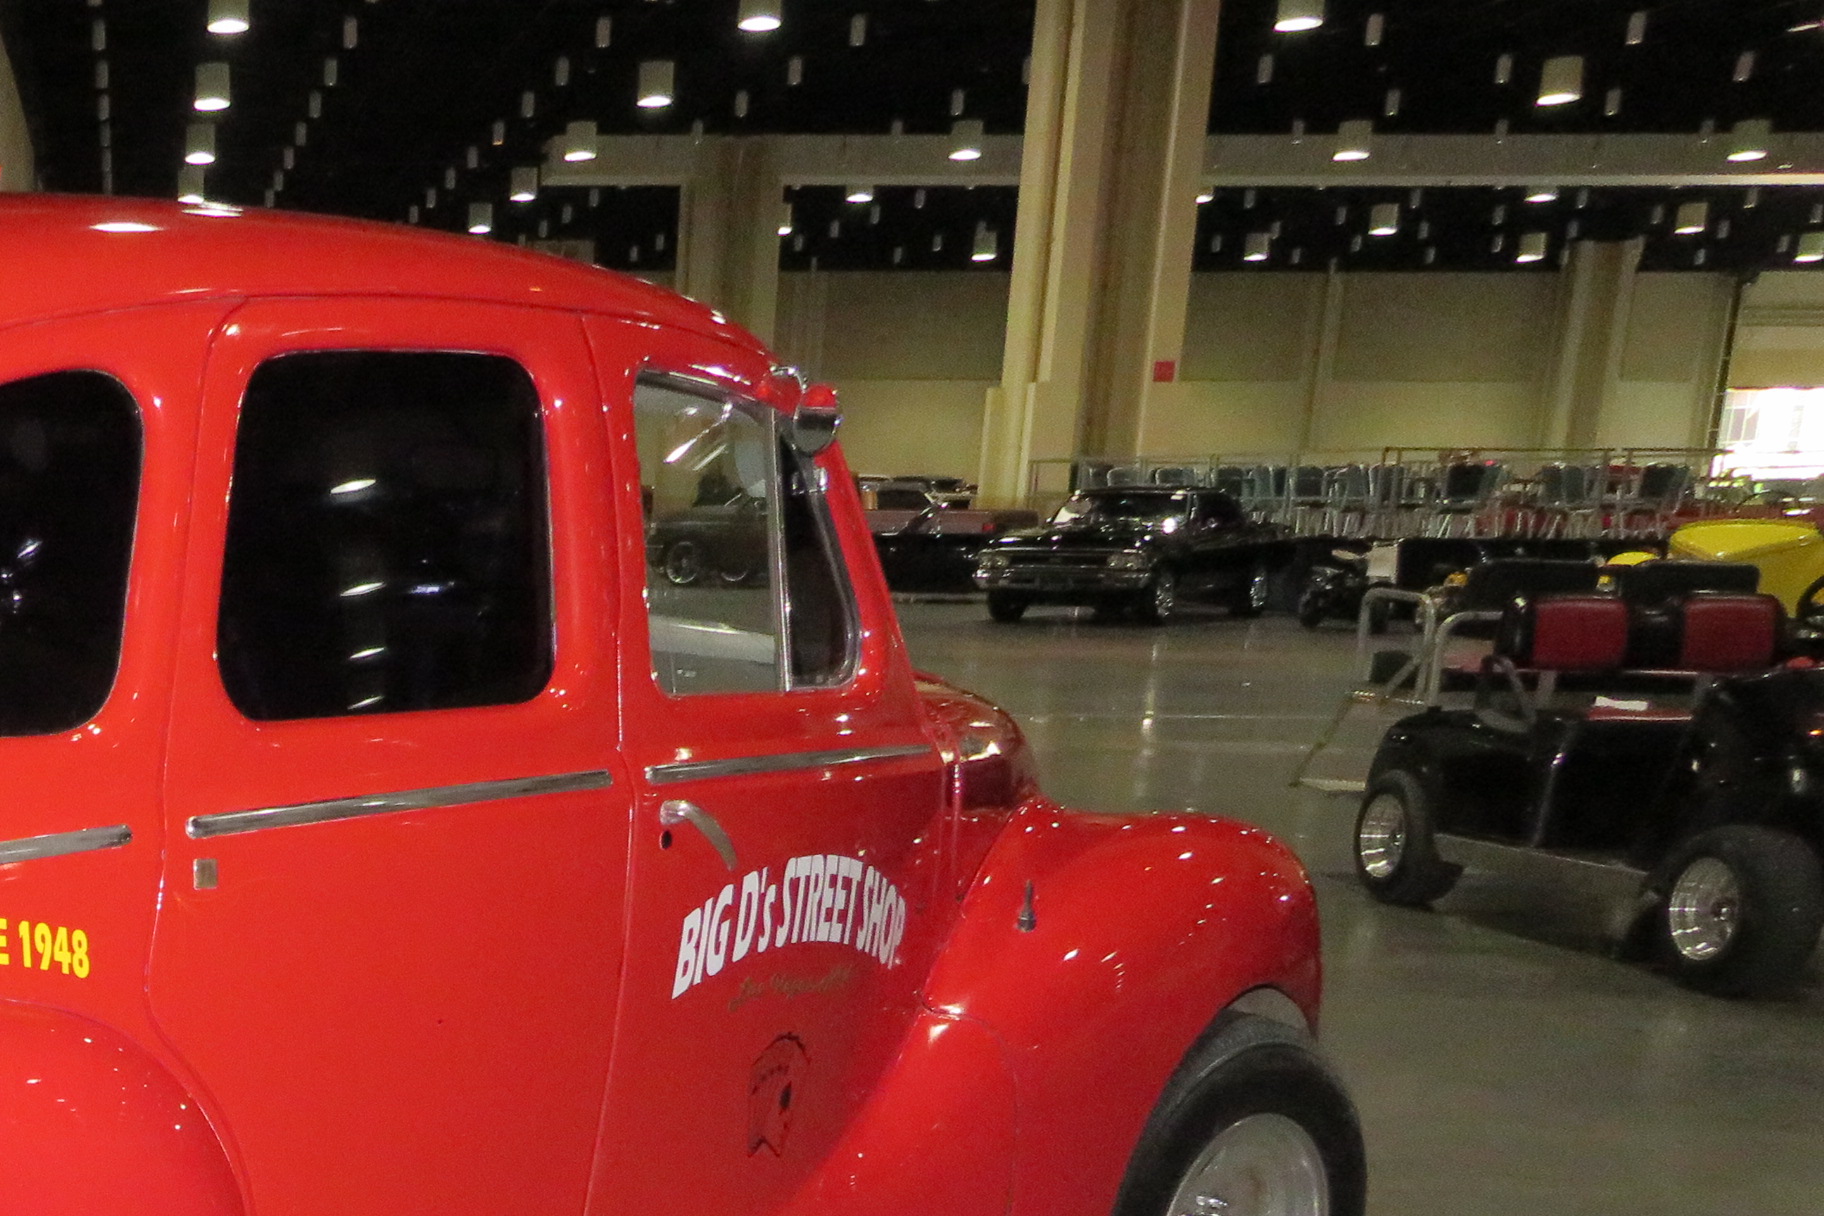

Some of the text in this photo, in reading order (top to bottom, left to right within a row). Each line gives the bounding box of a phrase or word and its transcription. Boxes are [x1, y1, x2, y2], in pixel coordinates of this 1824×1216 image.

[18, 920, 90, 979] 1948
[671, 883, 735, 1000] BIG
[775, 853, 864, 948] STREET
[855, 865, 907, 970] SHOP
